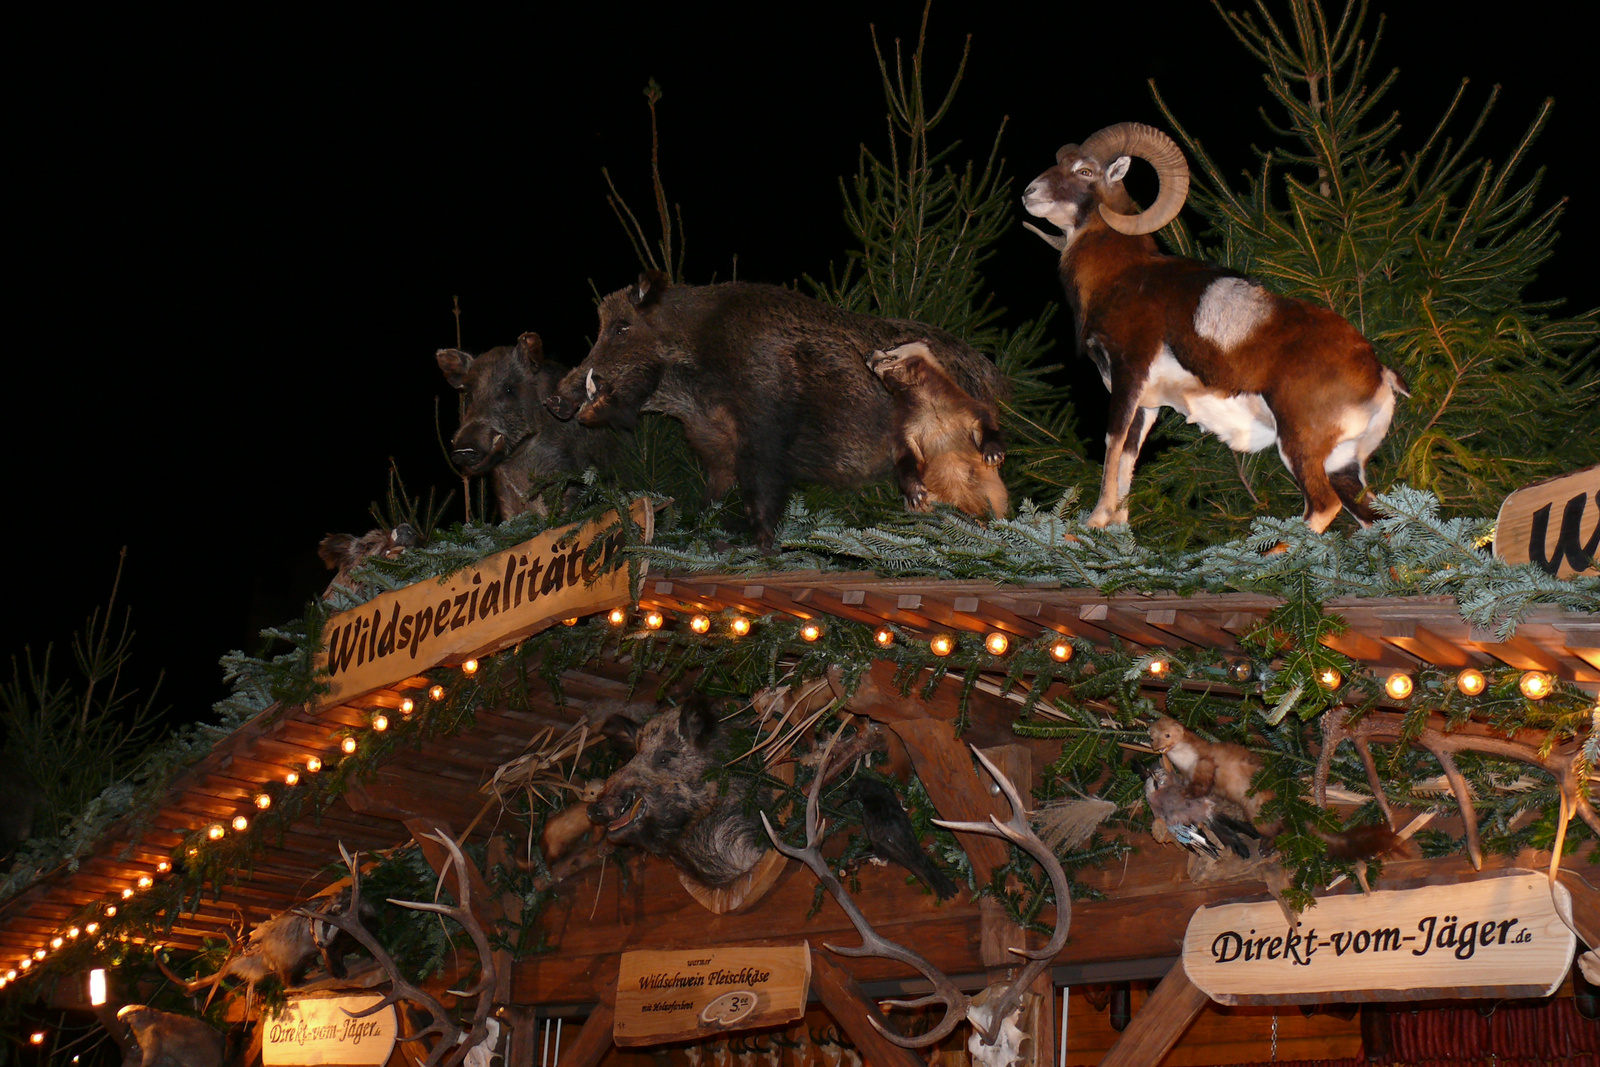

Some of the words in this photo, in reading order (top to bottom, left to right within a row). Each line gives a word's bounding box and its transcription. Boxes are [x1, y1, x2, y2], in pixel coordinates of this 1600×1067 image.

[1211, 915, 1532, 966] Direkt-vom-Jäger.de
[638, 970, 705, 990] Wildschwein
[707, 967, 770, 987] Fleischkäse
